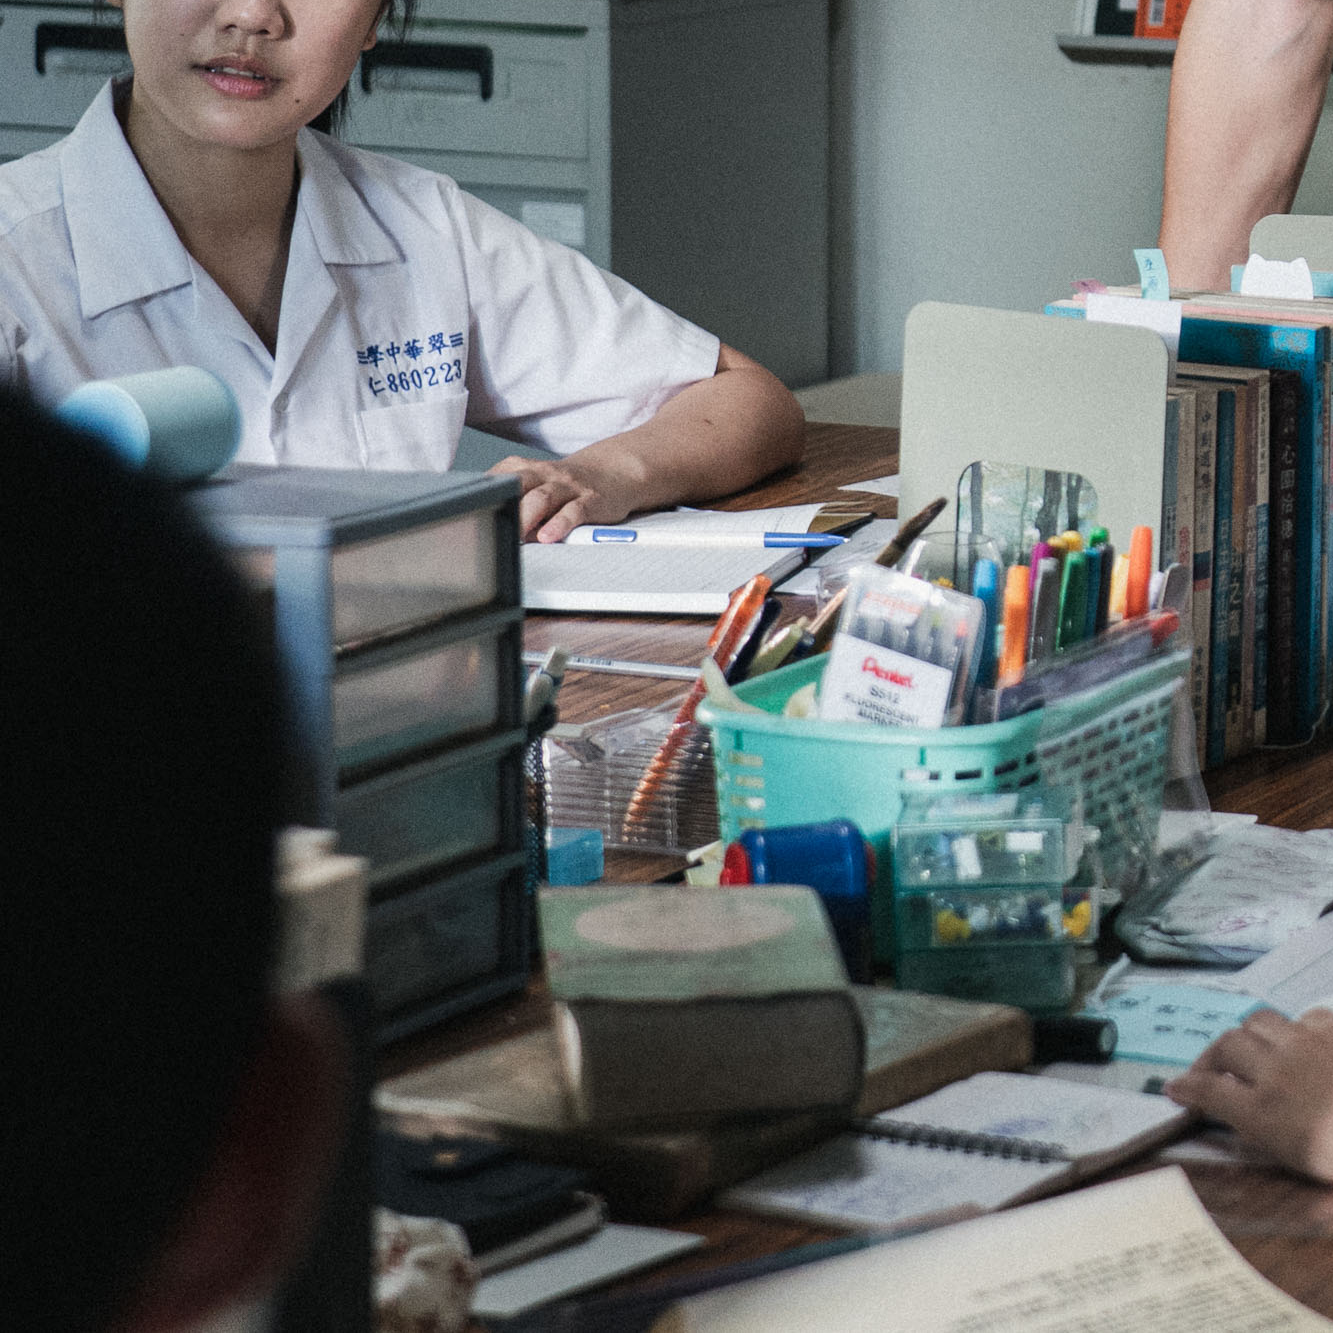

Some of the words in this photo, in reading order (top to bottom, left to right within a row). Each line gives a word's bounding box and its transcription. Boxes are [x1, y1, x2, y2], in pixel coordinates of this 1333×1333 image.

[369, 360, 462, 397] 仁860223
[862, 656, 914, 689] Pentel
[844, 693, 920, 724] FLUORESCENT
